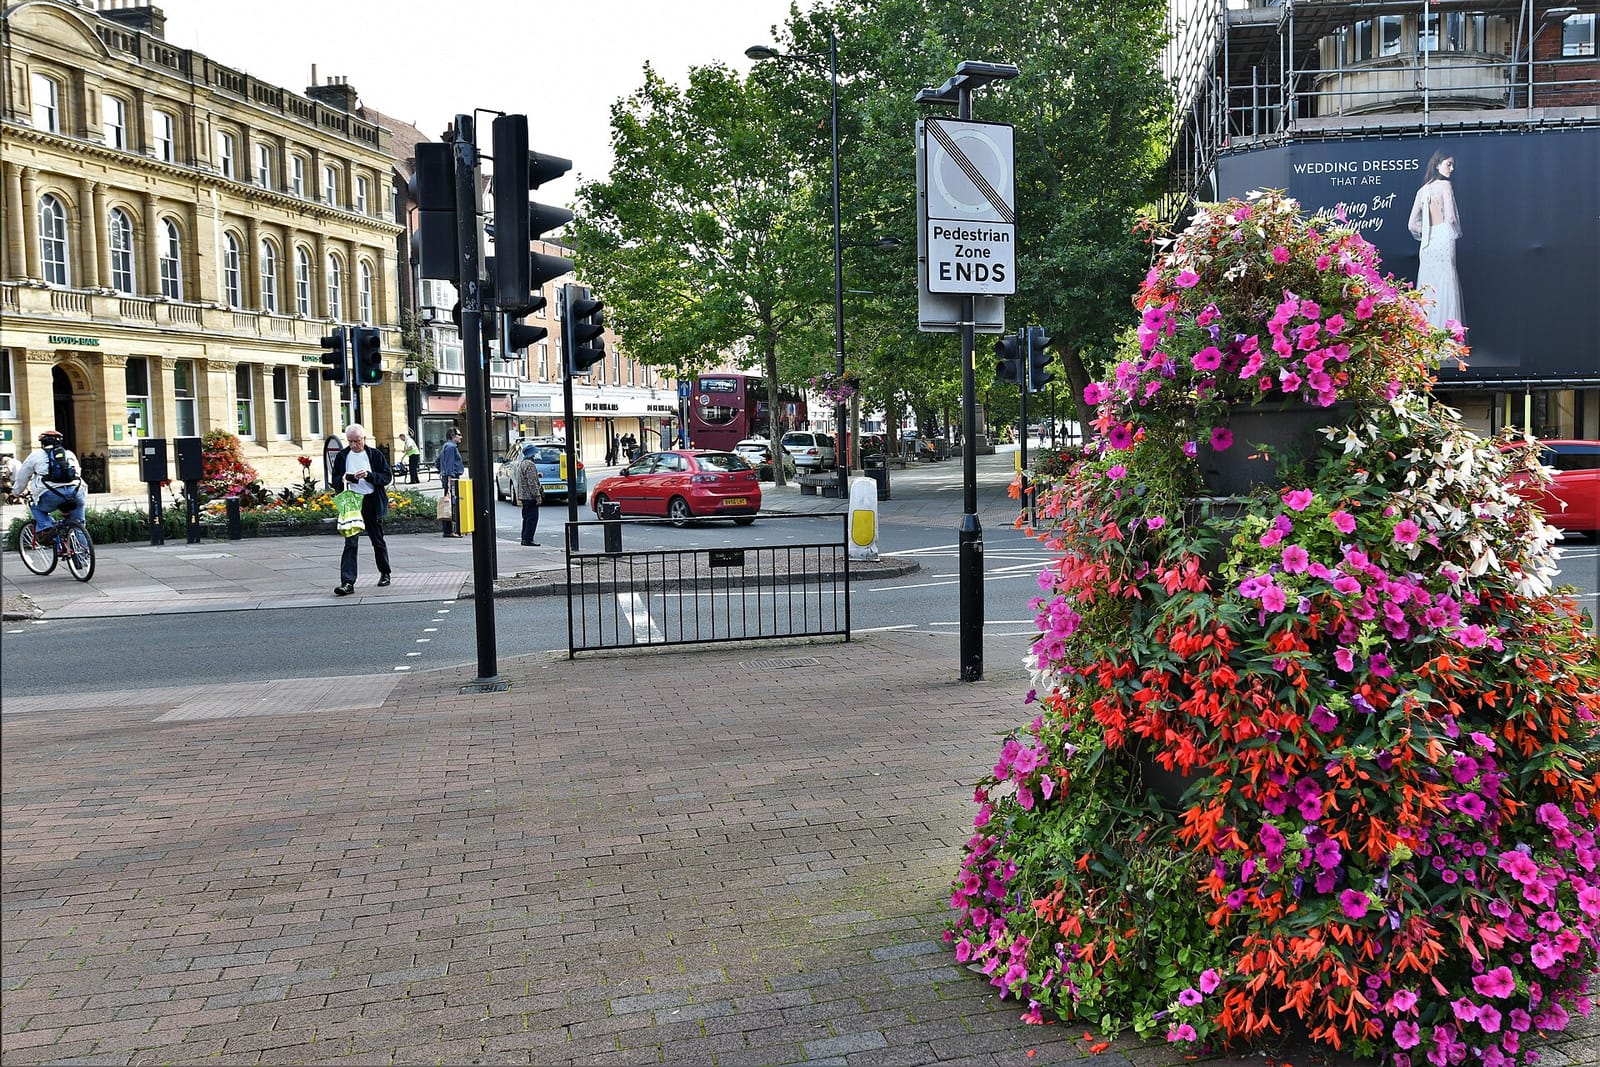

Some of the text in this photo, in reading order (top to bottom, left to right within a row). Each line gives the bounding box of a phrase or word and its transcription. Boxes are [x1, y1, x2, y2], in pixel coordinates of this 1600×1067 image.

[1293, 158, 1419, 174] WEDDING DRESSES
[1330, 175, 1382, 187] THAT ARE
[1372, 192, 1396, 211] But
[933, 226, 1010, 242] Pedestrian
[955, 244, 991, 258] Zone
[939, 262, 1006, 282] ENDS
[48, 335, 100, 347] LLOYDS BANK
